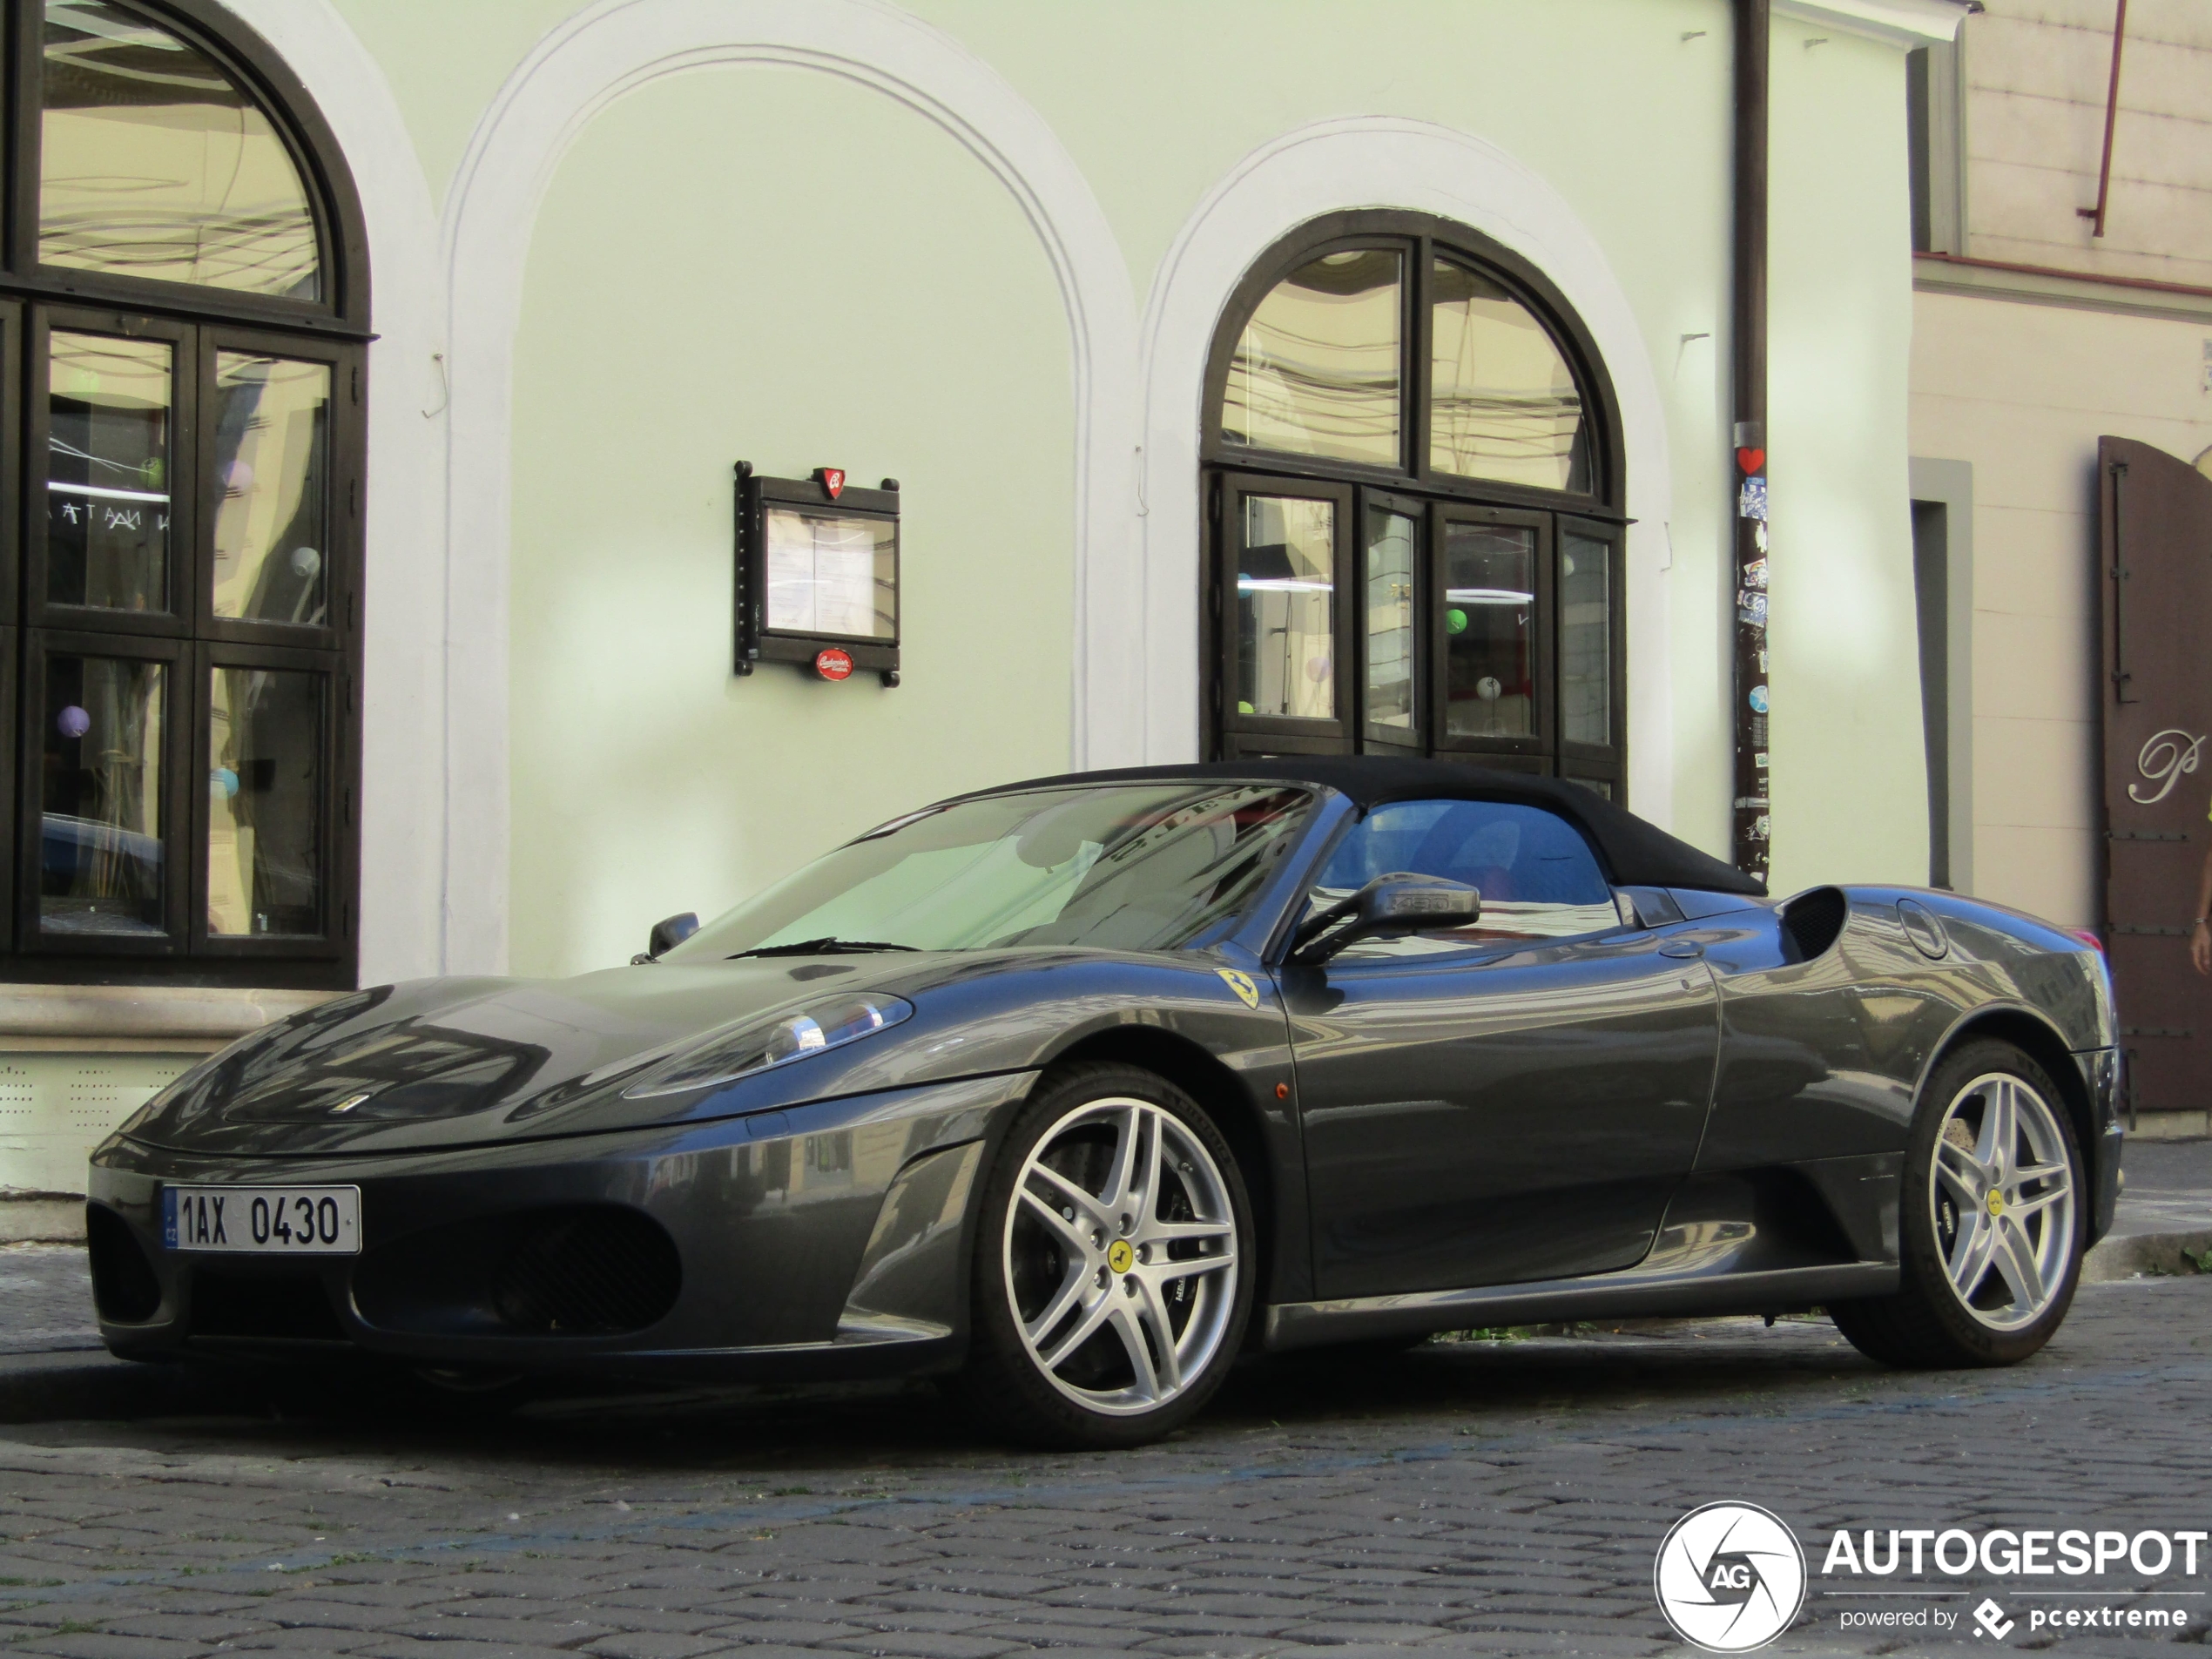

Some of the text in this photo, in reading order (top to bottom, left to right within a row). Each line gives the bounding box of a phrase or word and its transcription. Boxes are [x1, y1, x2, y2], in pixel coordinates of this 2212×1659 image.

[165, 1228, 178, 1242] CZ
[183, 1195, 340, 1244] 1AX 0430
